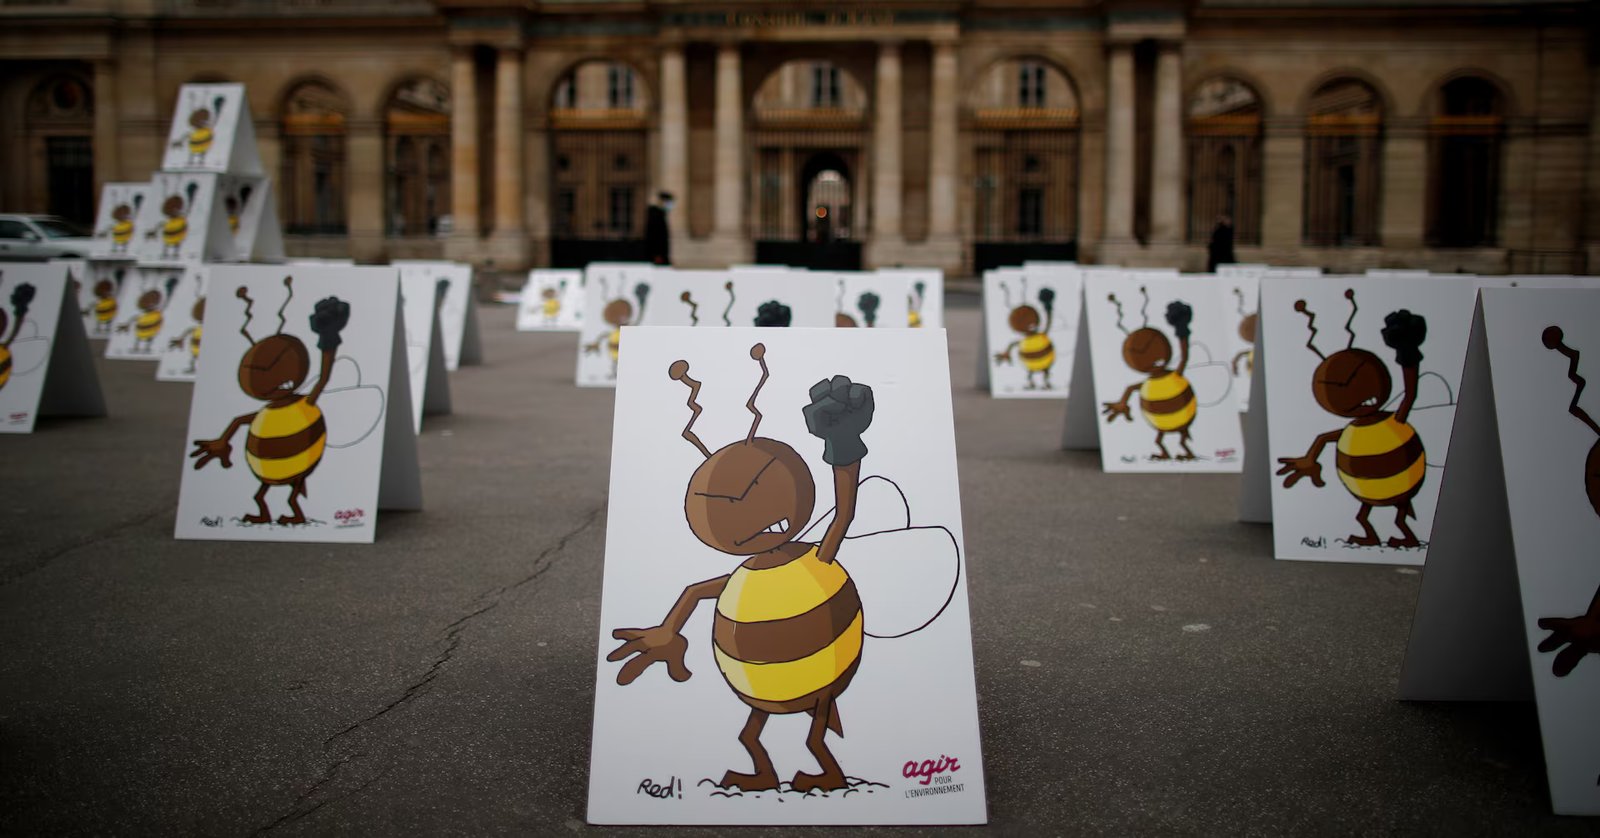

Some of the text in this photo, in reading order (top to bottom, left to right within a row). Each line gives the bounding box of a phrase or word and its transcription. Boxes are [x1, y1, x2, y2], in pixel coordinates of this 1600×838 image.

[1301, 536, 1327, 549] Red!
[903, 754, 961, 785] agir
[934, 775, 953, 785] POUR
[637, 776, 682, 800] Red!
[905, 783, 964, 798] L'ENVIRONNEMENT
